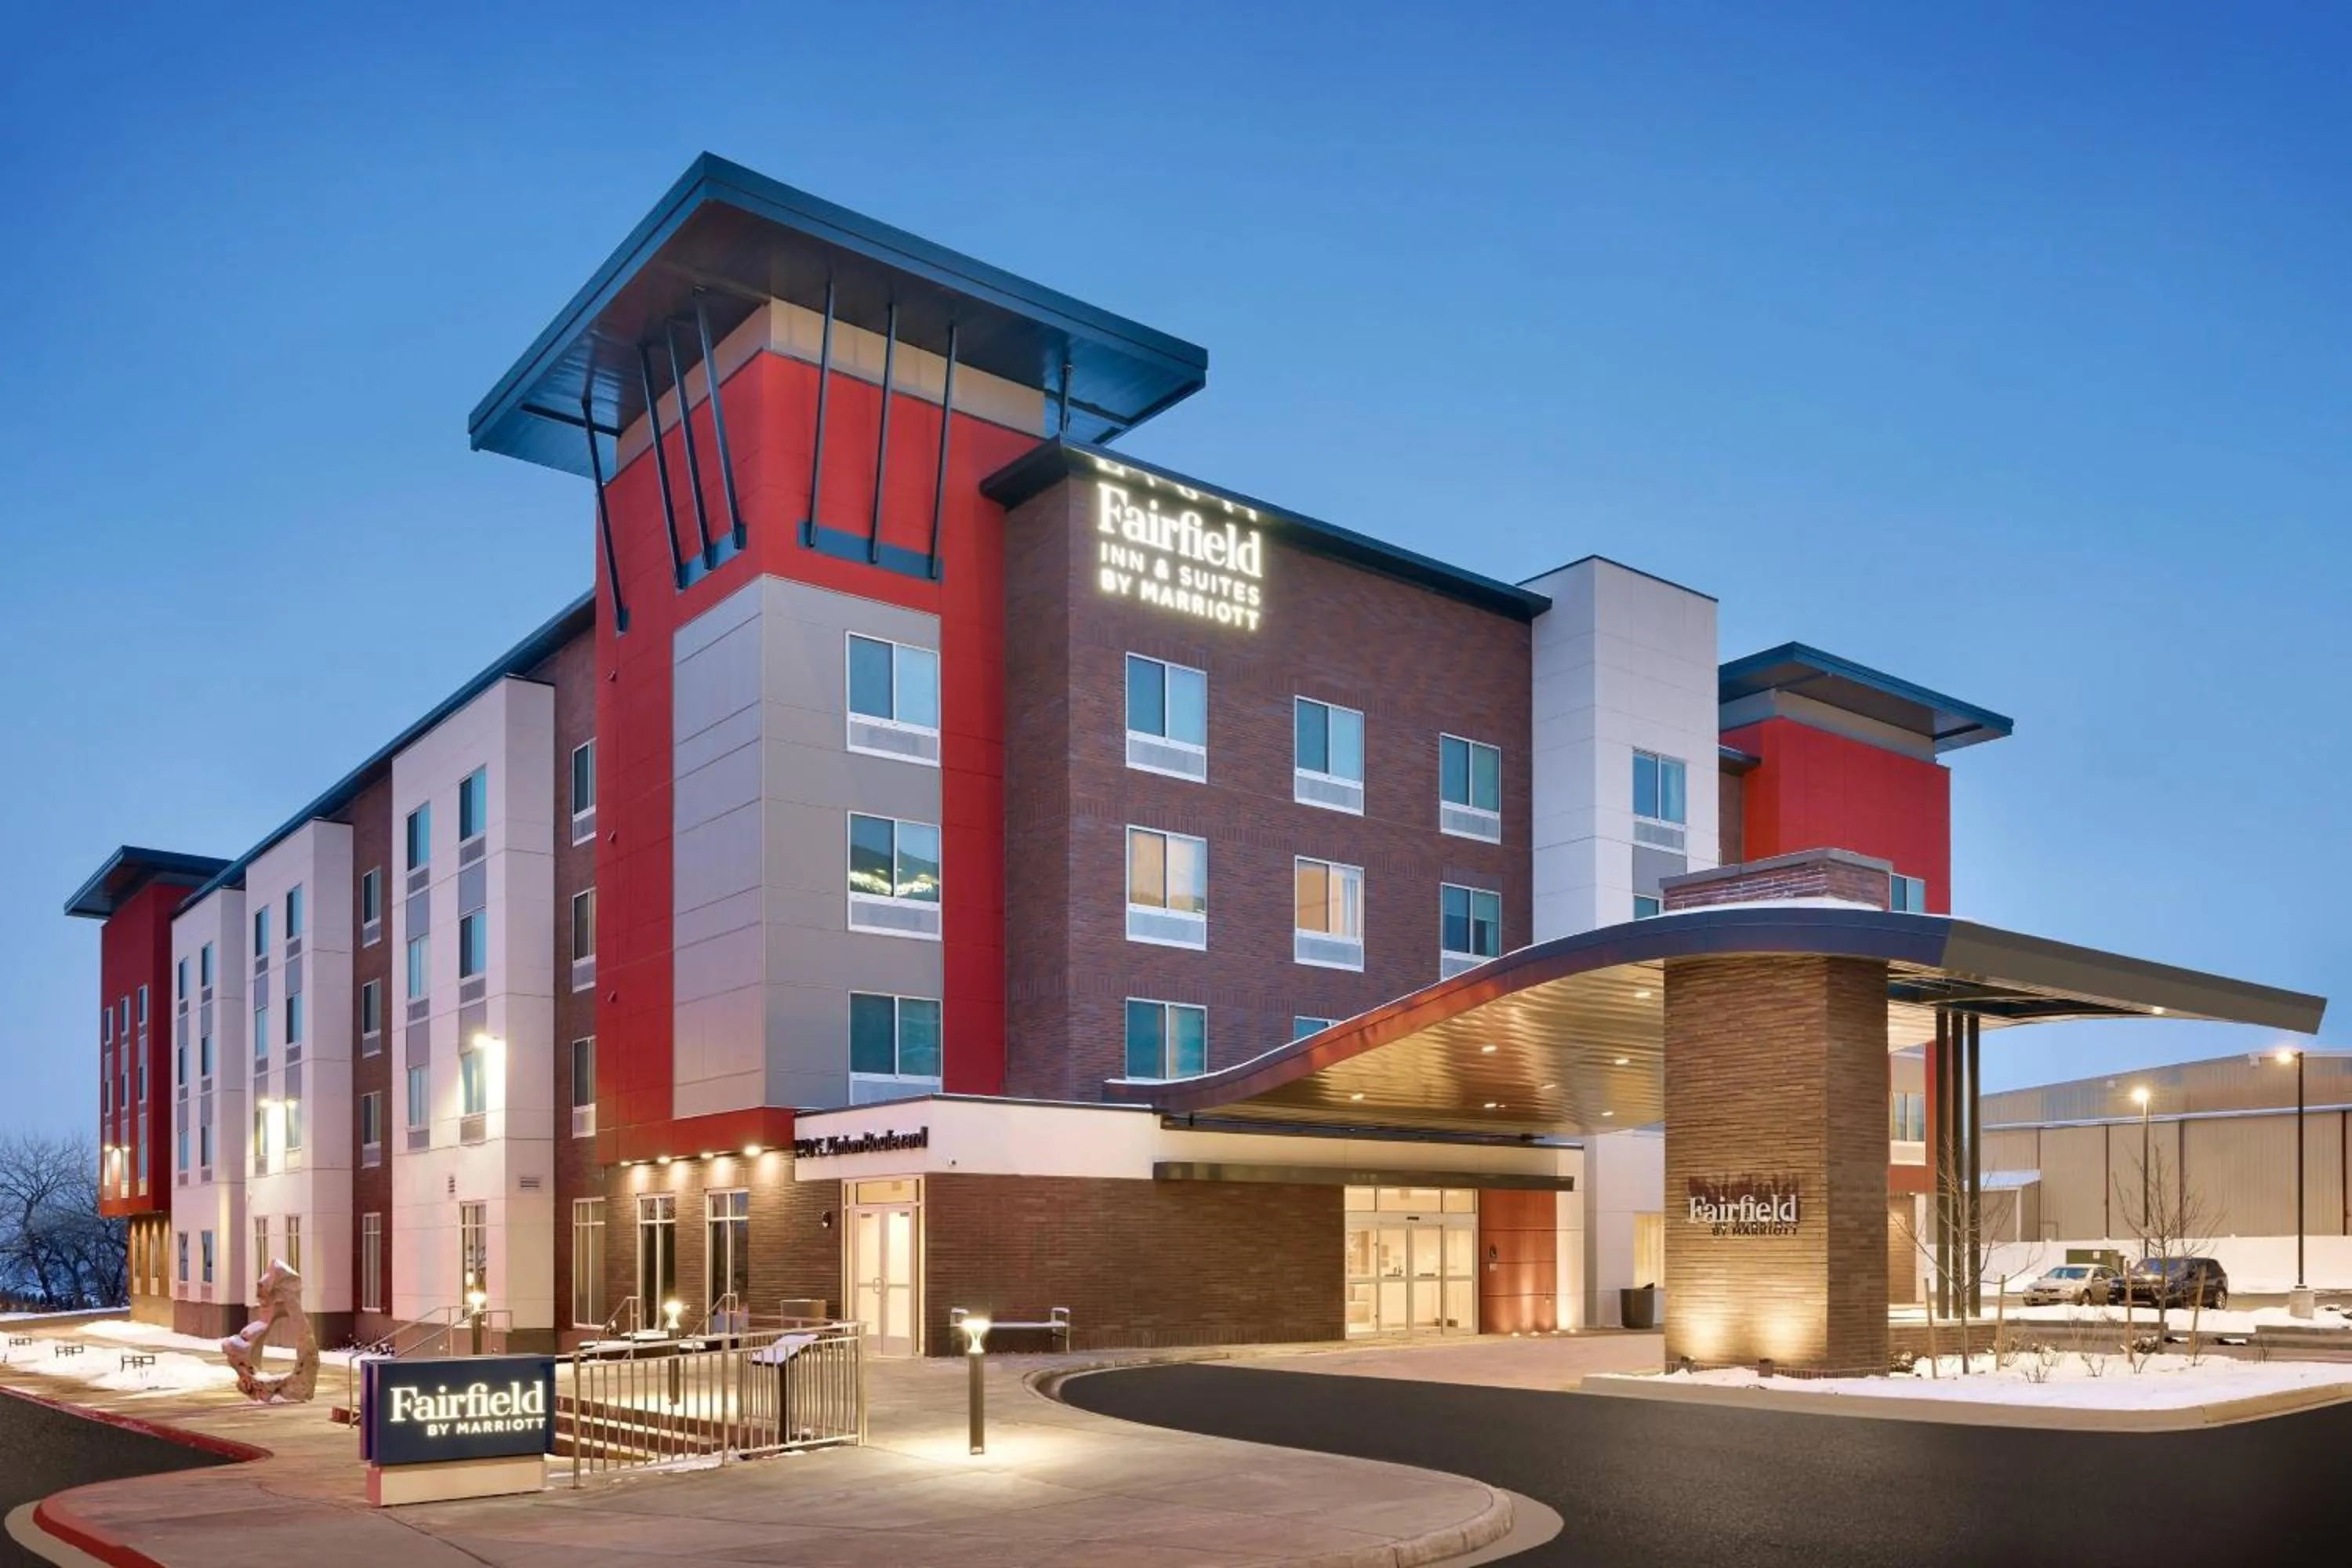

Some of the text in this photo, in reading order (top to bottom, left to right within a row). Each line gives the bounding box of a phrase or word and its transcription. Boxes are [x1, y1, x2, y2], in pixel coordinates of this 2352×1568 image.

[1098, 481, 1263, 579] Fairfield
[1100, 541, 1261, 606] INN & SUITES
[1100, 568, 1261, 631] BY MARRIOTT
[1688, 1194, 1798, 1224] Fairfield
[1711, 1225, 1797, 1236] BY MARRIOTT
[390, 1380, 546, 1422] Fairfield
[427, 1417, 546, 1436] BY MARRIOTT
